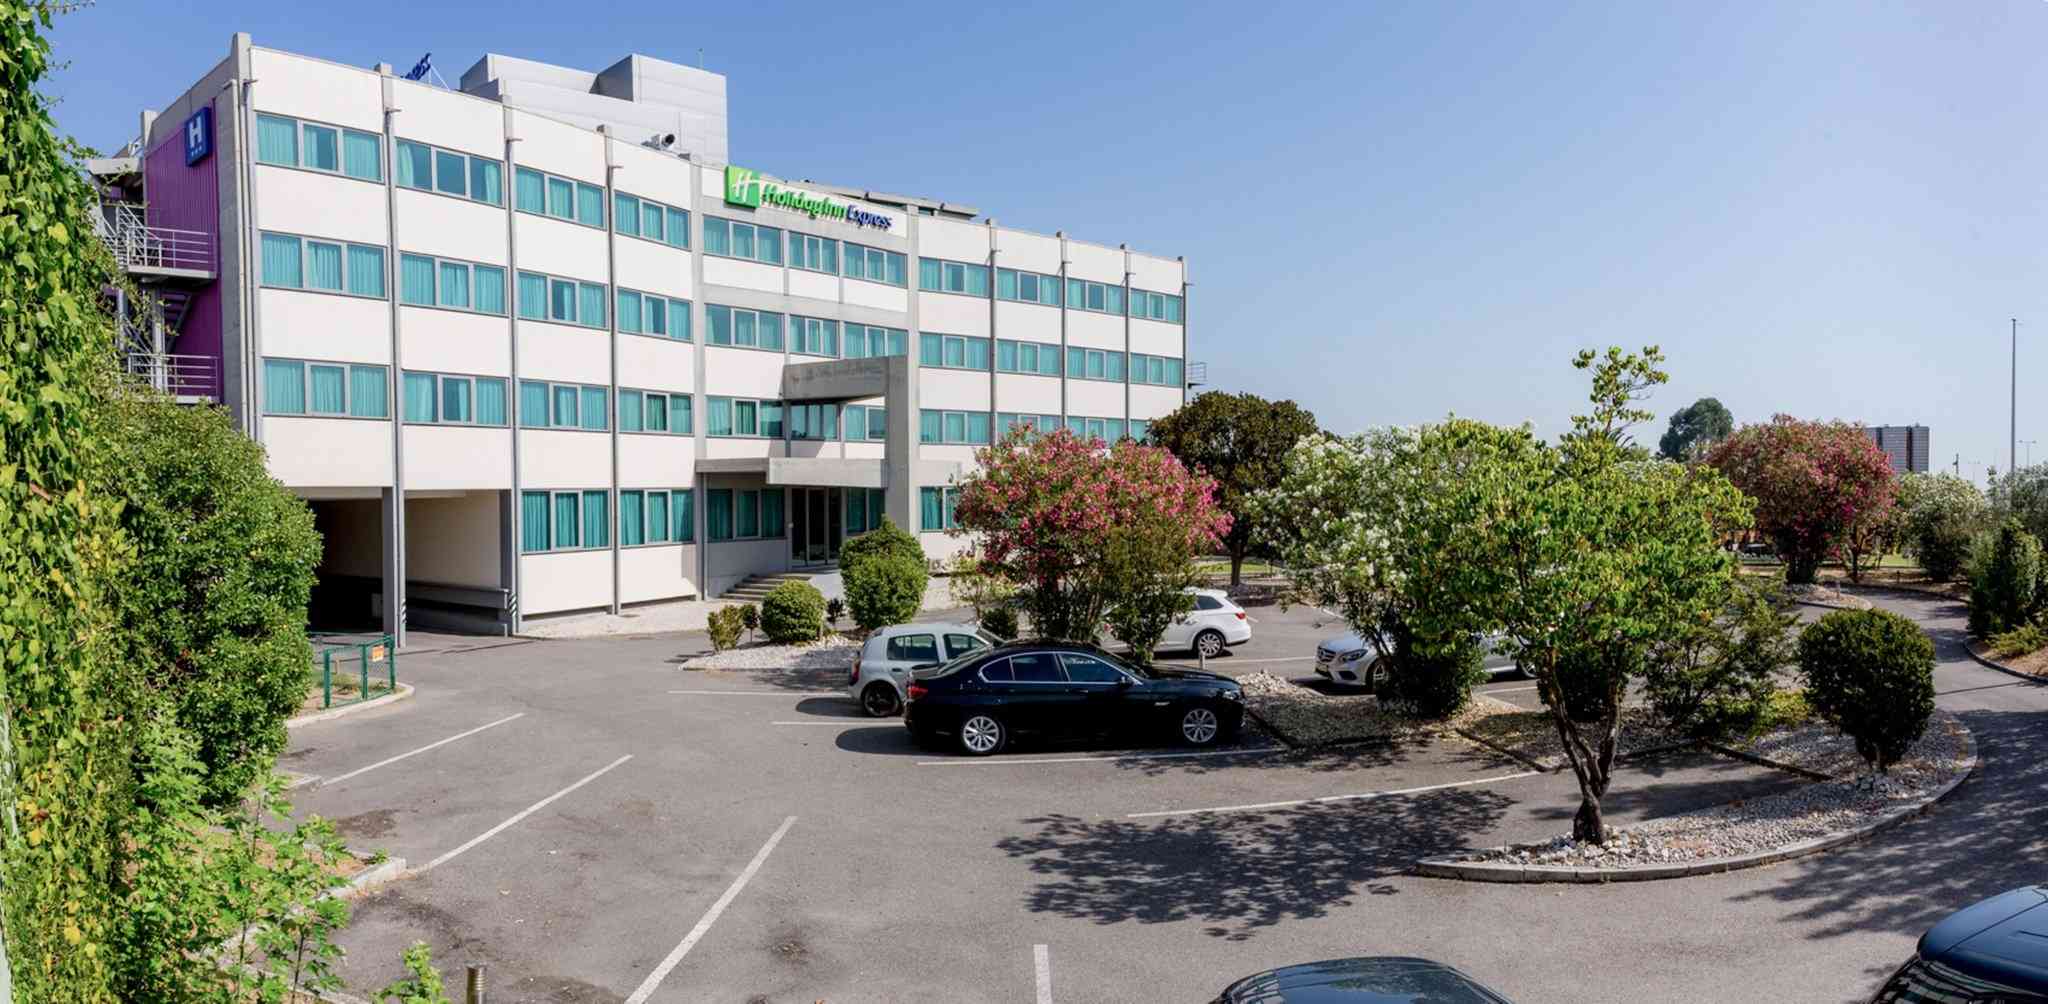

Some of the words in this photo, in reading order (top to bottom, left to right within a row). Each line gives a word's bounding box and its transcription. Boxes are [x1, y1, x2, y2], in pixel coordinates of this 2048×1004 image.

[189, 116, 202, 149] H
[762, 184, 823, 217] Holiday
[847, 204, 892, 228] Express
